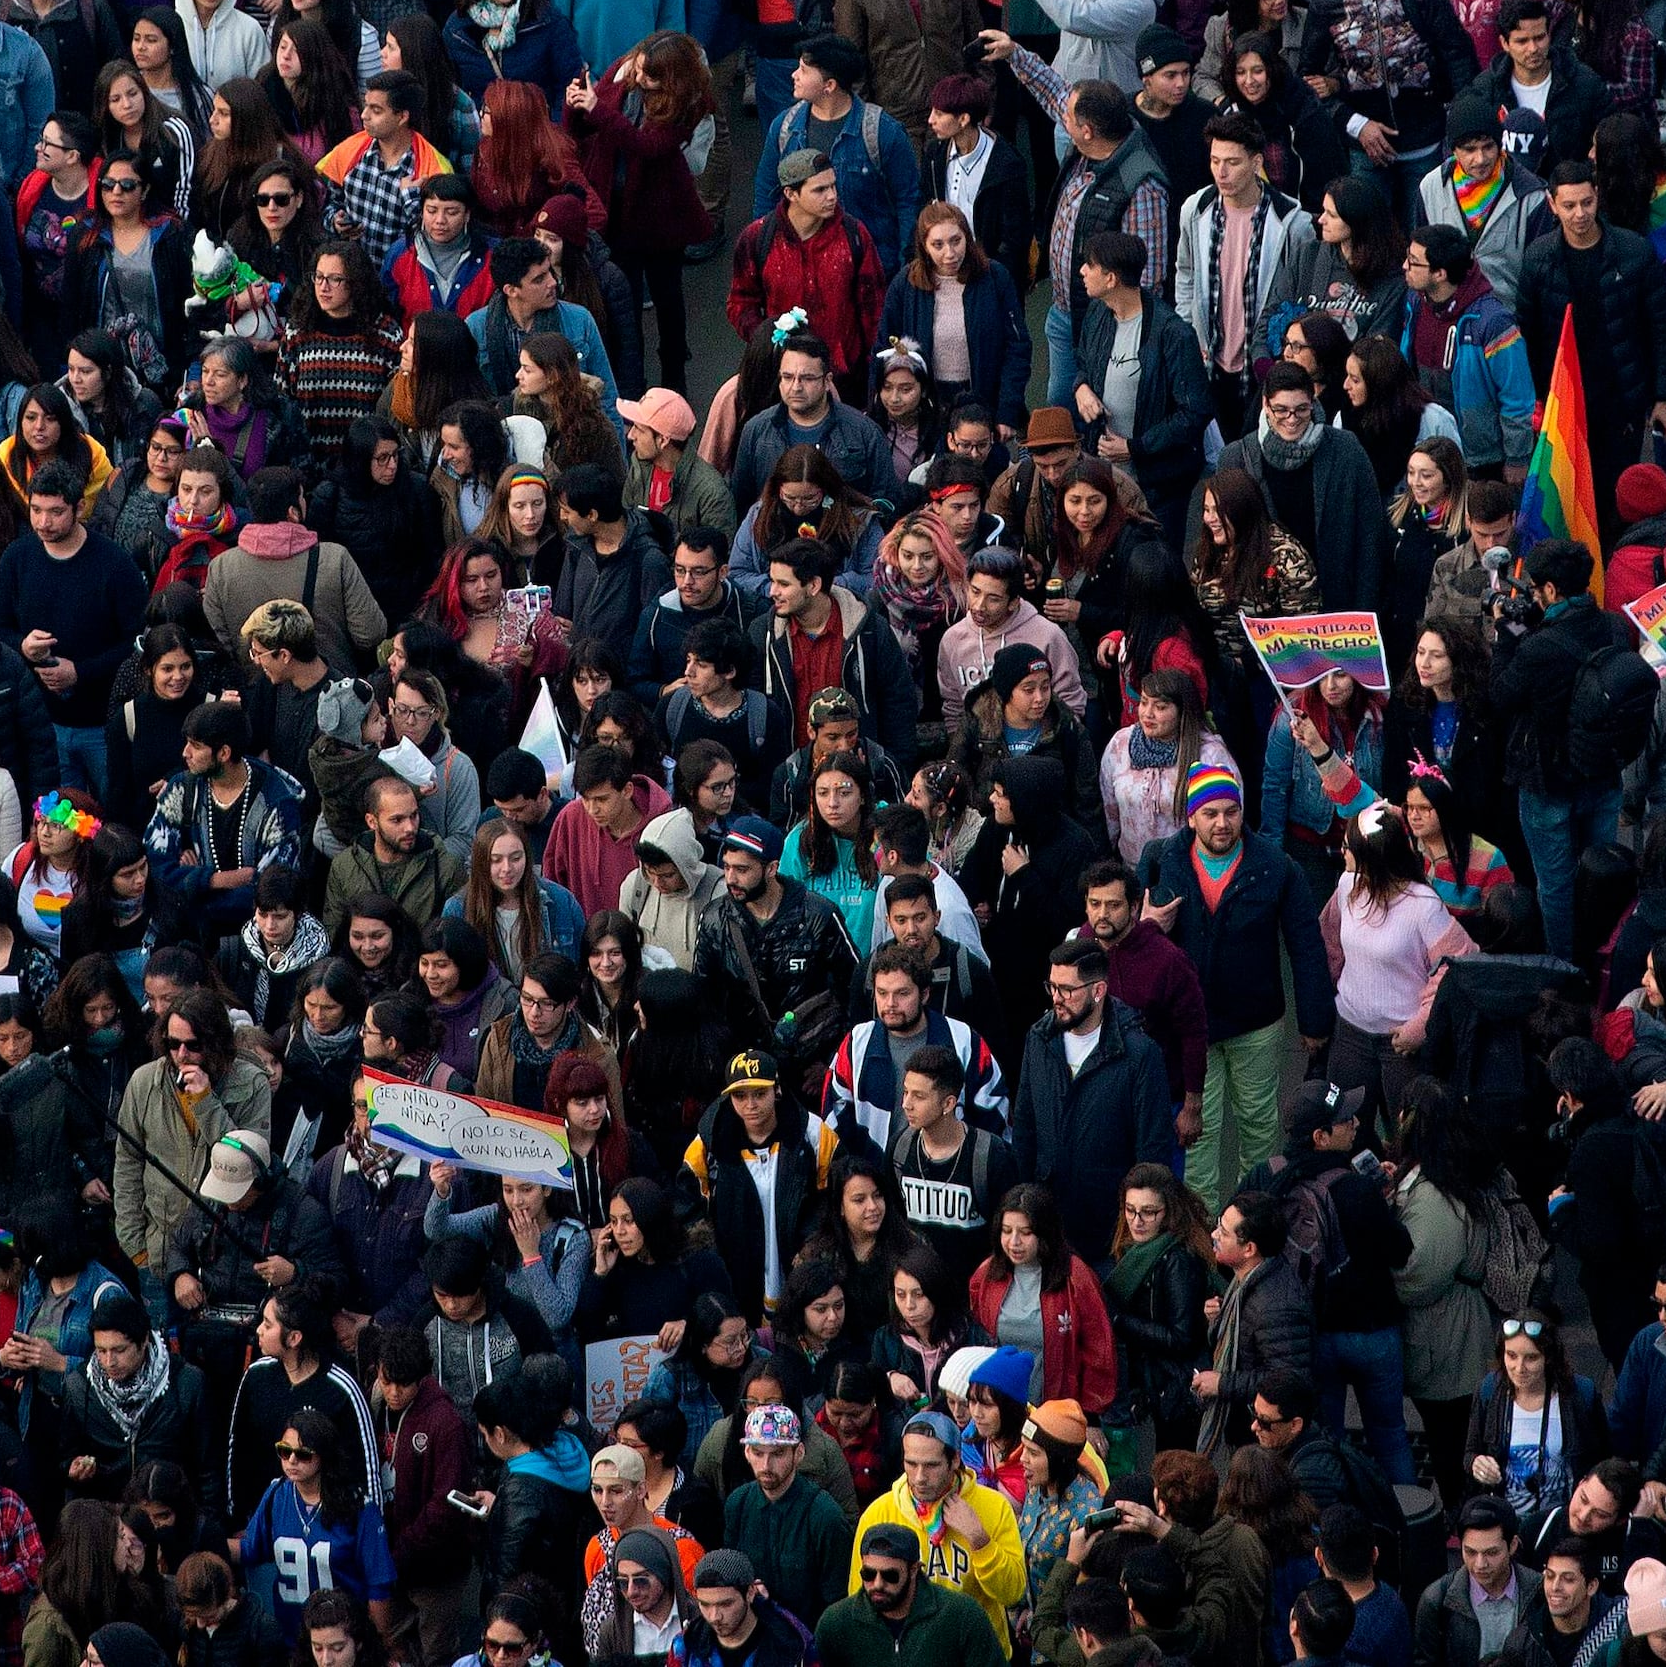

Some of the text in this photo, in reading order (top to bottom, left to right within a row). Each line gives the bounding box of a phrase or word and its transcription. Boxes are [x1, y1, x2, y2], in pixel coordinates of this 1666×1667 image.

[1502, 129, 1534, 153] NY
[273, 1536, 333, 1603] 91
[921, 1540, 970, 1585] AP
